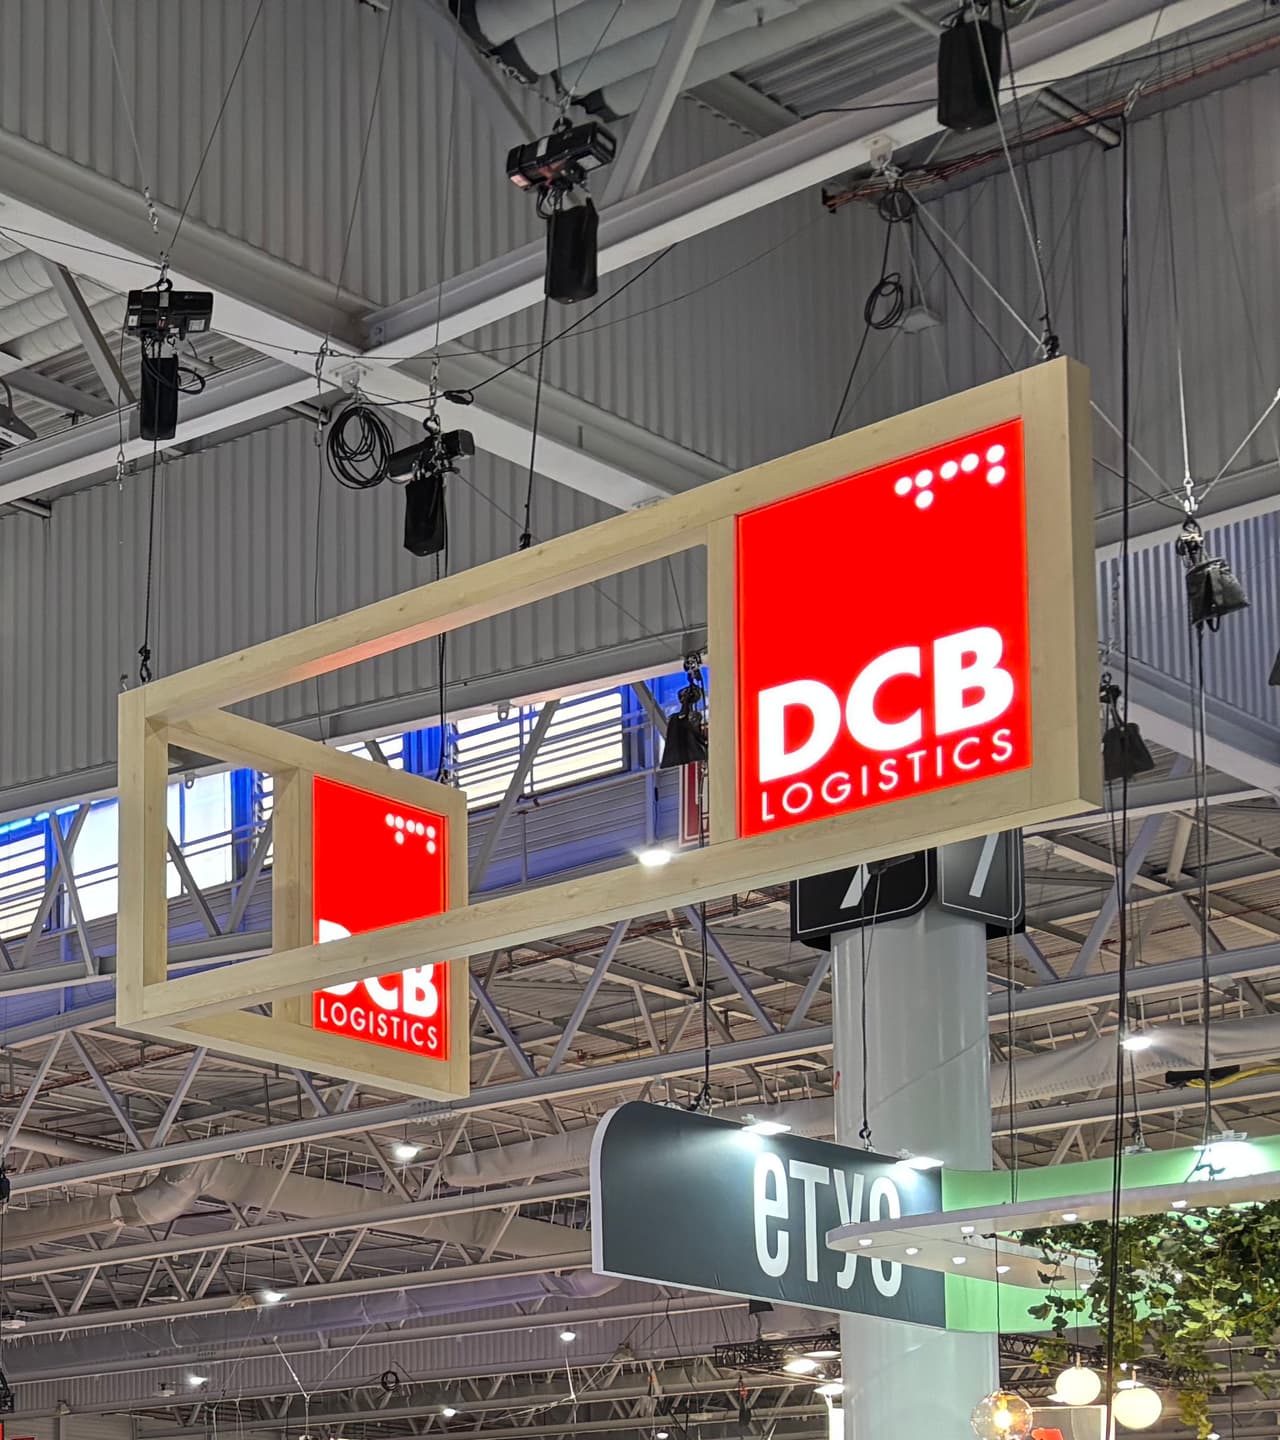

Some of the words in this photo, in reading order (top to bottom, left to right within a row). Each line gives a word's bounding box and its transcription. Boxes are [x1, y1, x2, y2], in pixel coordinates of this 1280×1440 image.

[757, 626, 1015, 783] DCB
[761, 728, 1014, 822] LOGISTICS
[319, 997, 438, 1049] LOGISTICS
